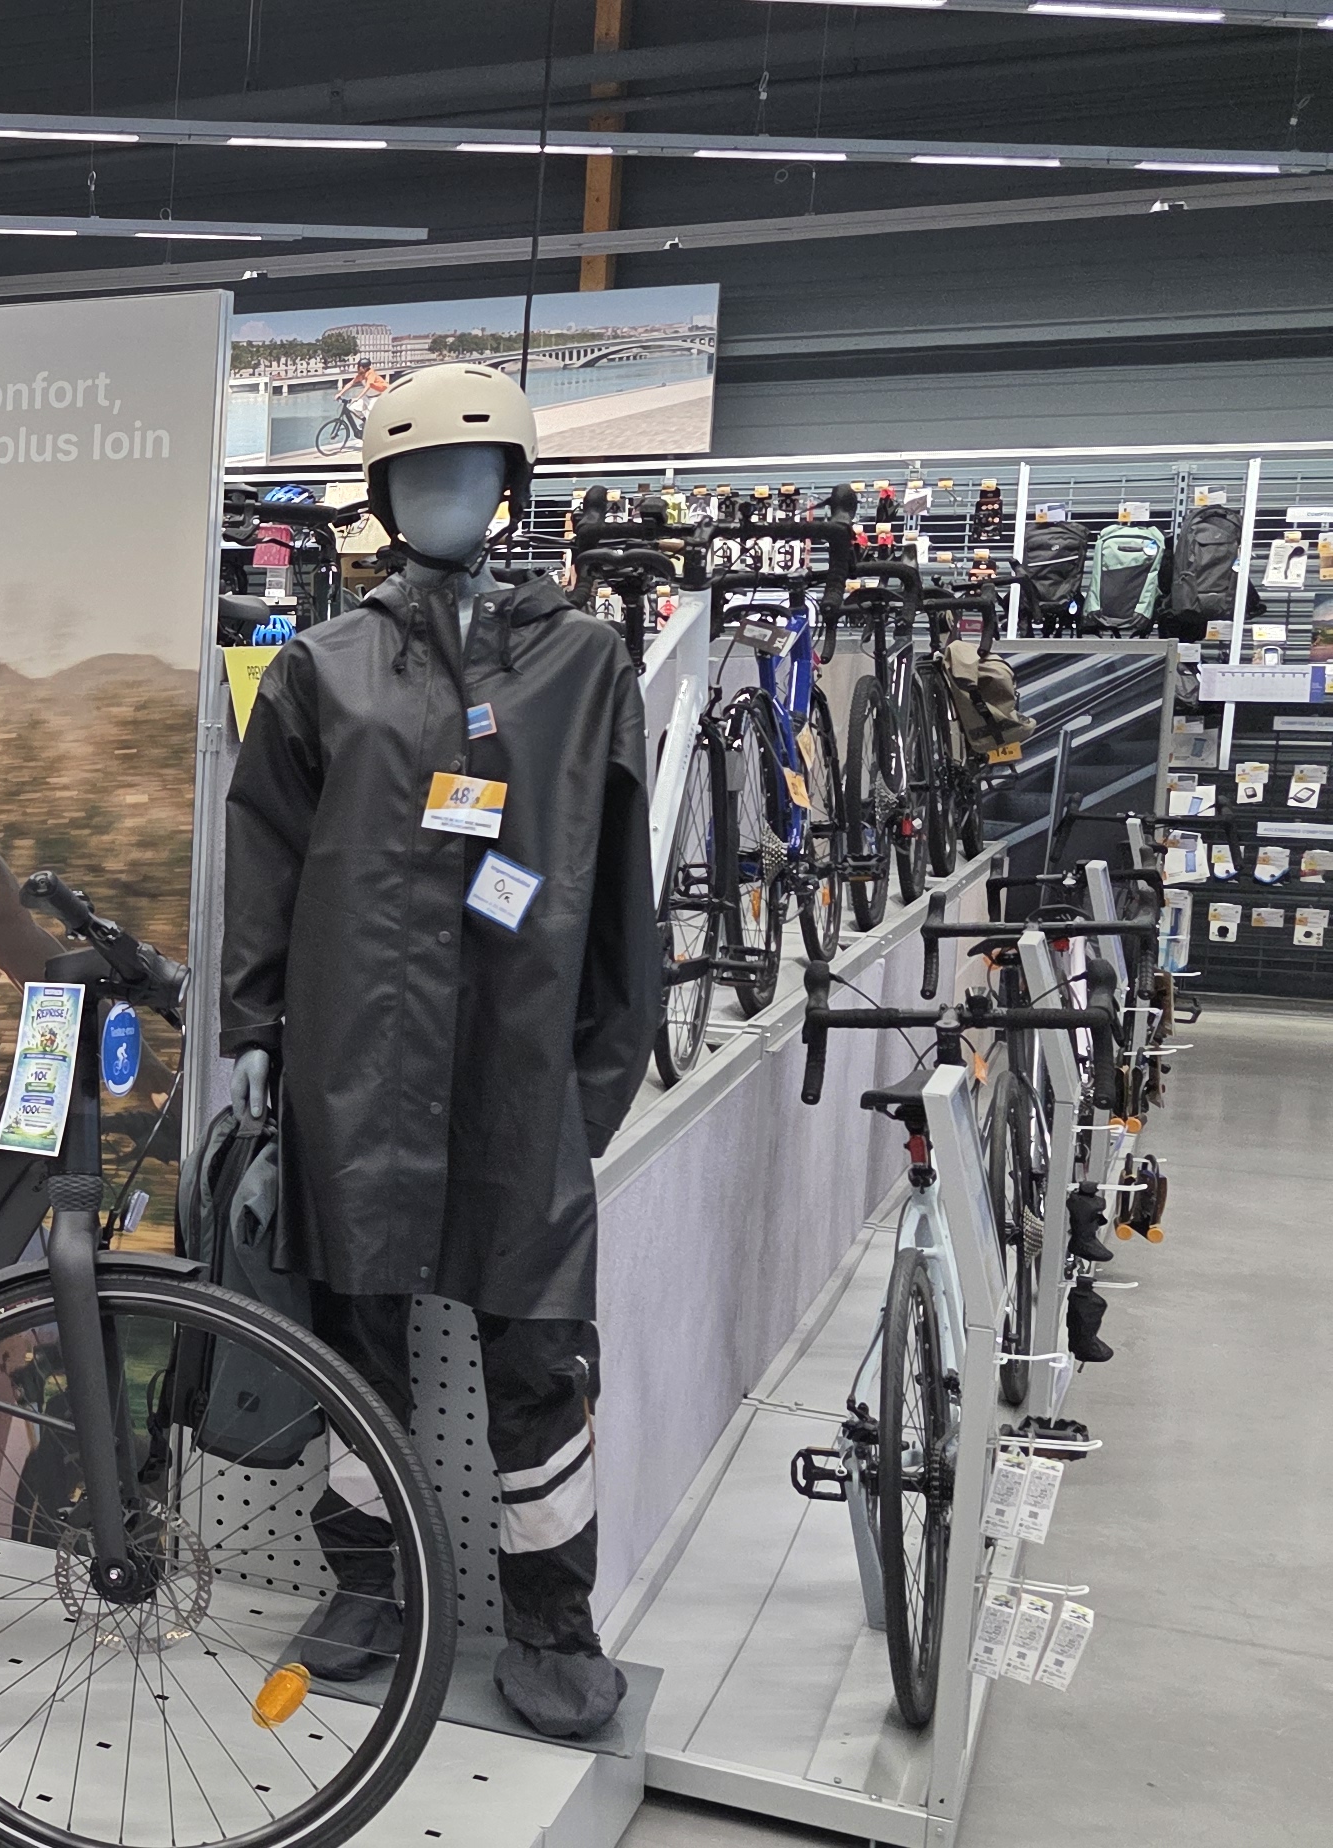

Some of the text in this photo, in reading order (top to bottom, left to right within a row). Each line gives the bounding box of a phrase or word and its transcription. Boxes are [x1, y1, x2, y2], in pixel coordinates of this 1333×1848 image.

[92, 420, 171, 461] loin
[773, 636, 788, 650] XL
[449, 786, 471, 806] 48
[36, 1008, 64, 1021] REPRISE
